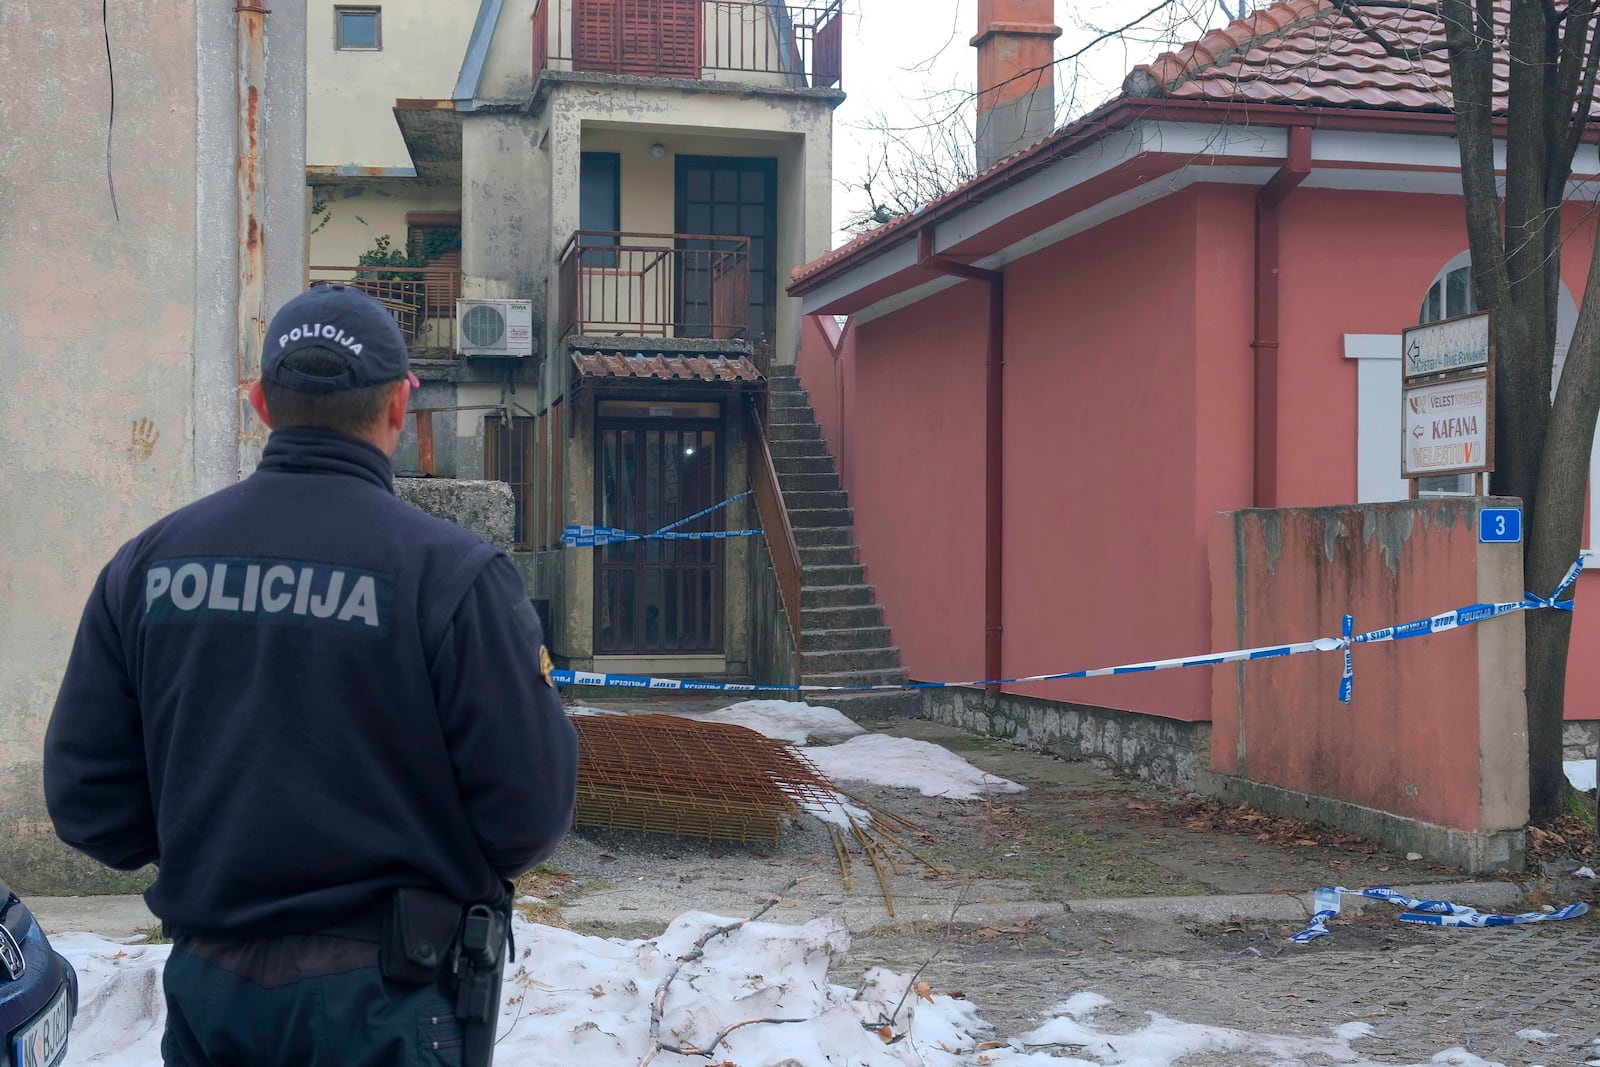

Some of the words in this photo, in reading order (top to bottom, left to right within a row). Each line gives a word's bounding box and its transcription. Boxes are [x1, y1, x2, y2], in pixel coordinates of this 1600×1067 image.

[278, 323, 363, 355] POLICIJA
[1432, 416, 1478, 440] KAFANA
[1413, 441, 1481, 468] VELESTOVO
[1495, 515, 1506, 535] 3
[146, 562, 379, 627] POLICIJA
[1434, 615, 1455, 627] STOP
